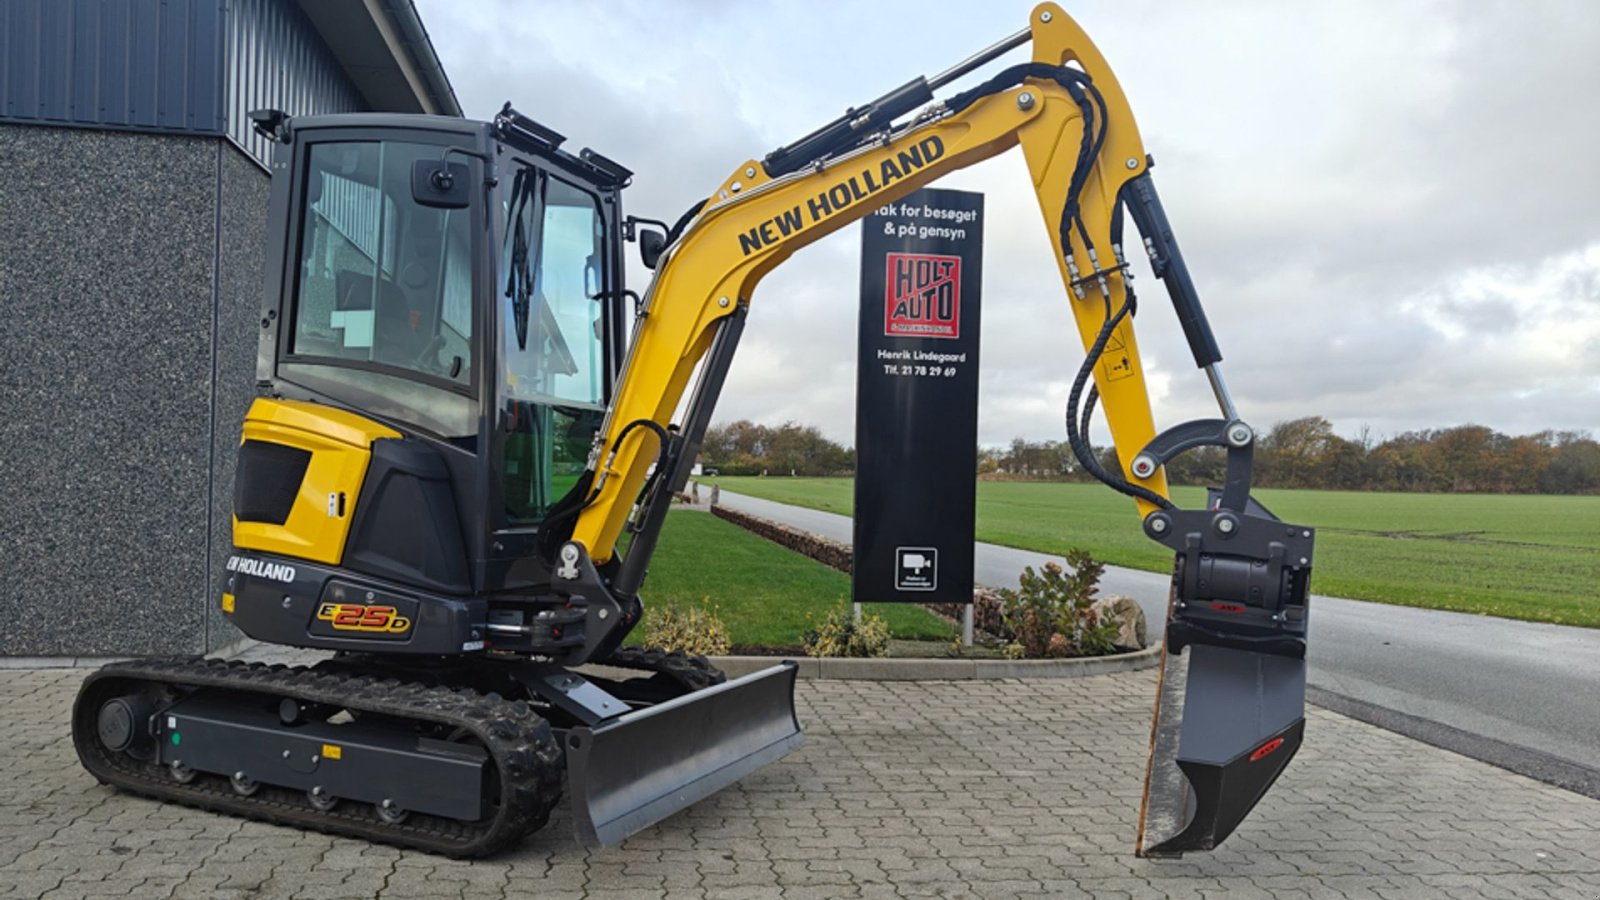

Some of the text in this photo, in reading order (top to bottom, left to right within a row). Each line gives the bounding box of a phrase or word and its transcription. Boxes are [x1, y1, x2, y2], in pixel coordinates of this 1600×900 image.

[737, 134, 945, 256] NEW HOLLAND
[874, 203, 978, 223] ak for besøget
[883, 221, 966, 241] & på gensyn
[896, 258, 954, 300] HOLT
[892, 280, 954, 321] AUTO
[877, 349, 966, 364] Henrik Lindegaard
[901, 365, 913, 376] 21
[914, 366, 927, 376] 78
[929, 366, 942, 376] 29
[944, 367, 957, 377] 69
[237, 557, 296, 583] HOLLAND
[318, 603, 409, 630] E25D
